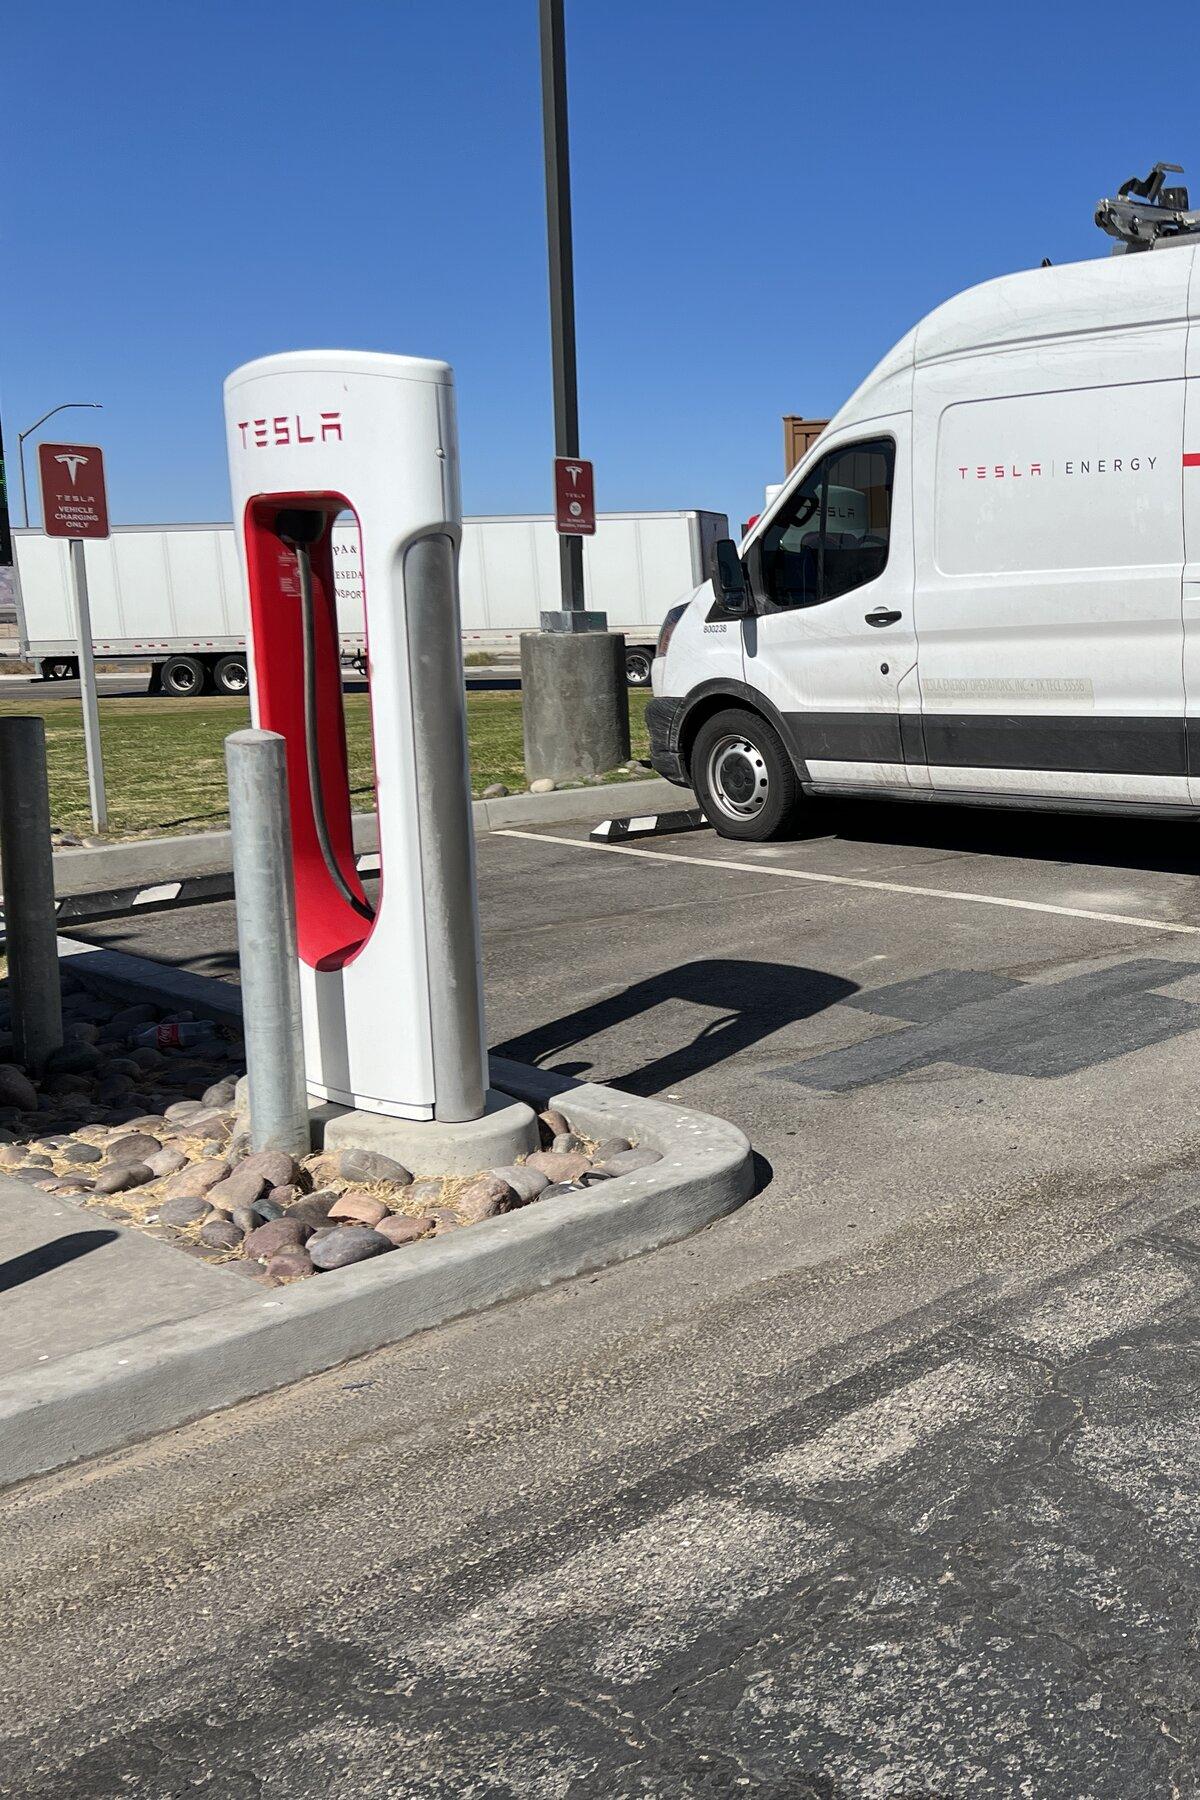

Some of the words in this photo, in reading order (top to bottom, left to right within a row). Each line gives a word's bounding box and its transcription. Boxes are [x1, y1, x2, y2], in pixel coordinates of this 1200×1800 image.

[237, 412, 343, 449] TESLA
[958, 463, 1041, 480] TESLA
[1065, 456, 1157, 475] ENERGY
[55, 494, 95, 503] TESLA
[58, 505, 94, 514] VEHICLE
[815, 506, 855, 520] ESLA
[54, 513, 99, 522] CHARGING
[65, 521, 90, 529] ONLY
